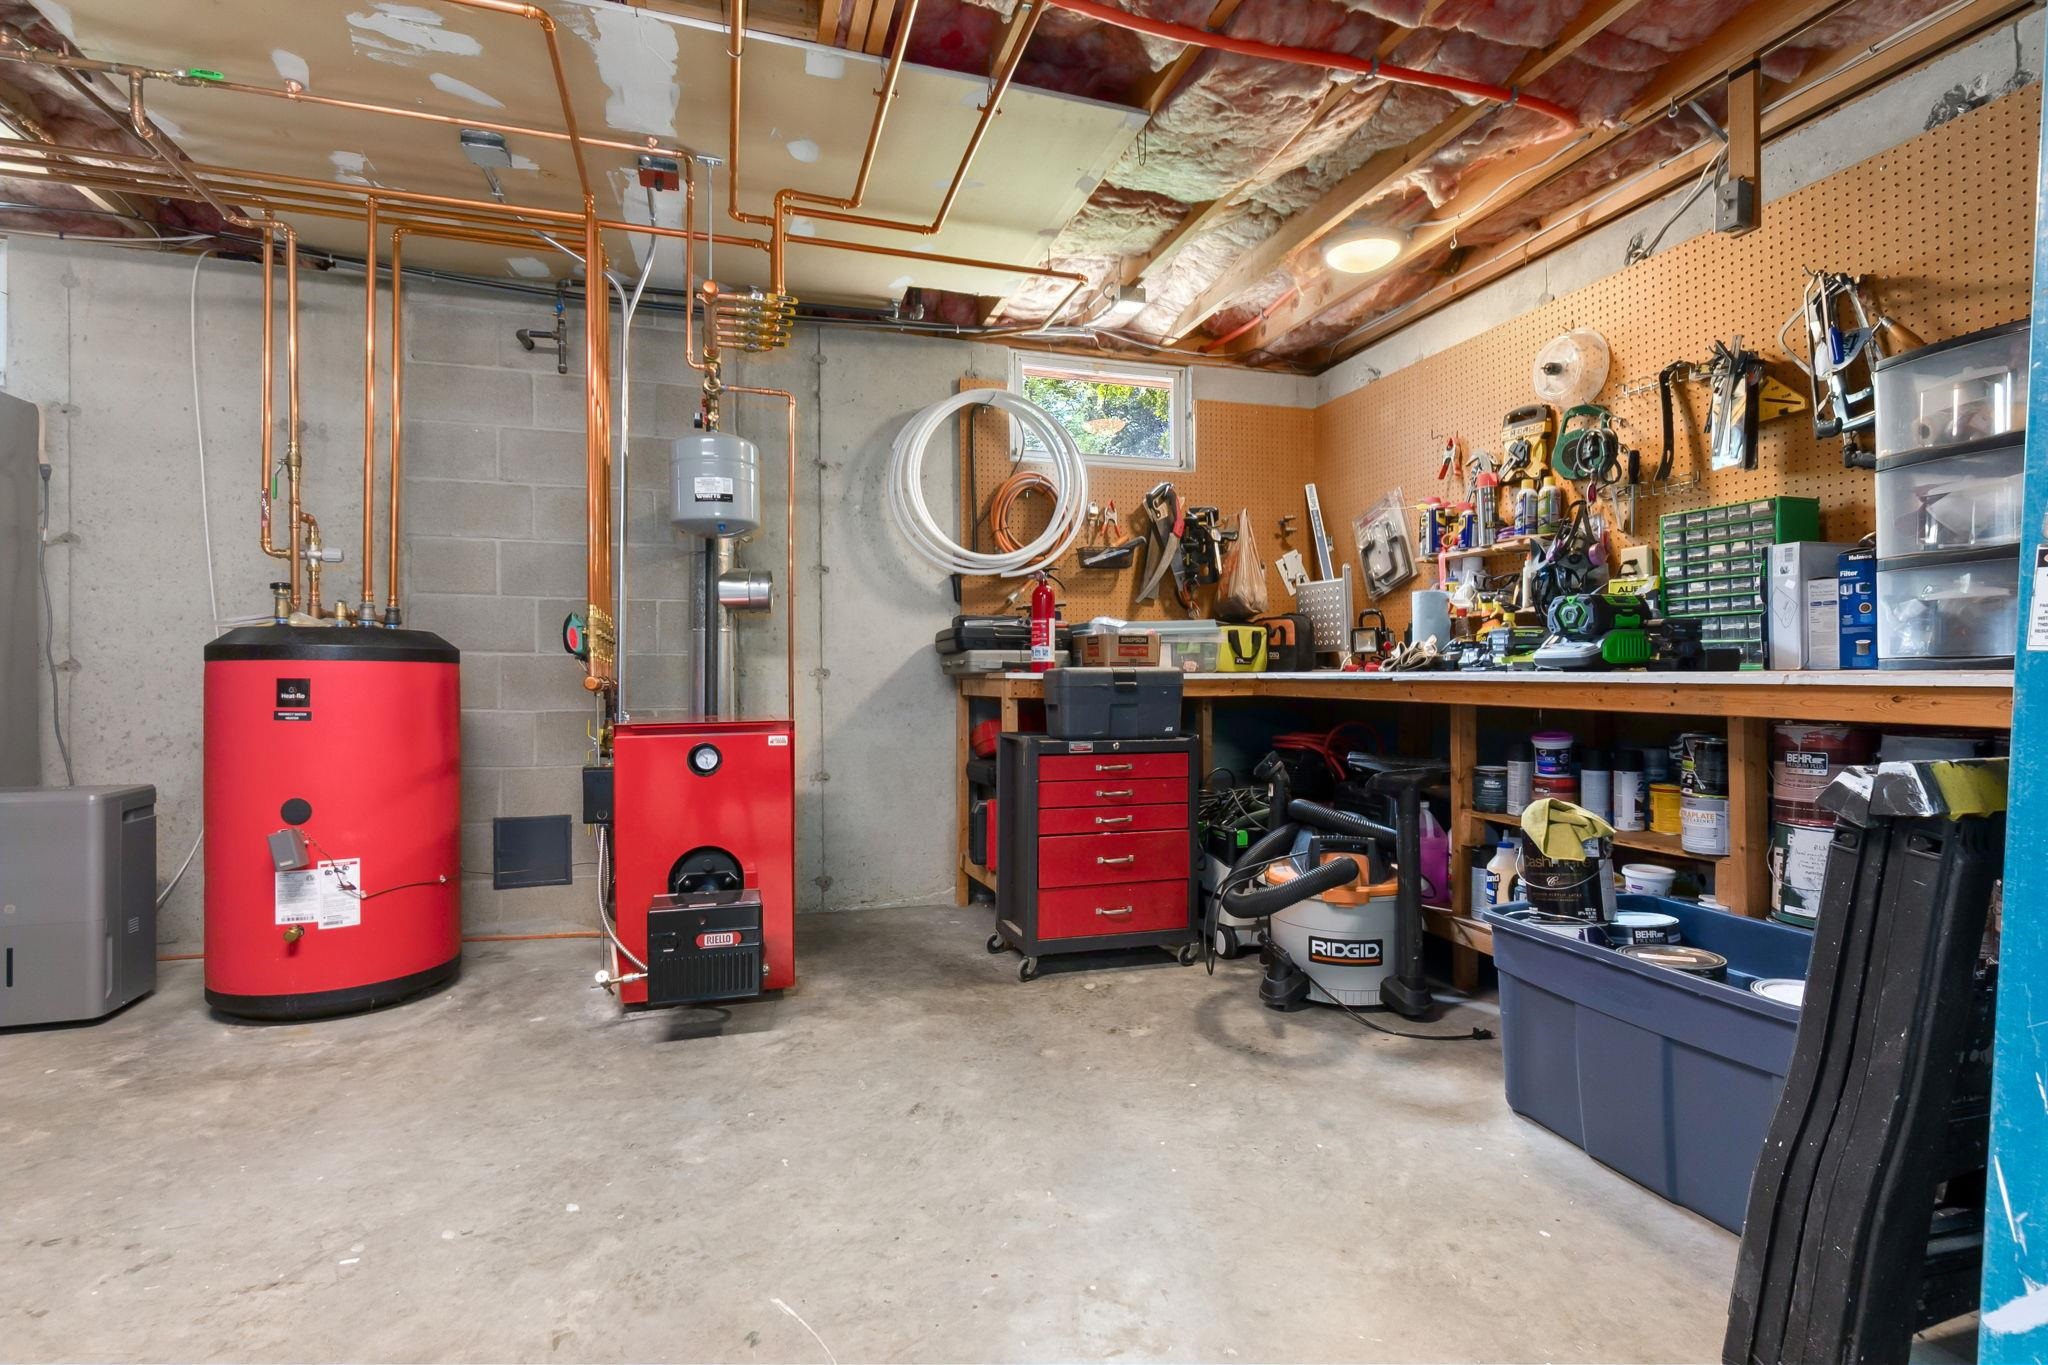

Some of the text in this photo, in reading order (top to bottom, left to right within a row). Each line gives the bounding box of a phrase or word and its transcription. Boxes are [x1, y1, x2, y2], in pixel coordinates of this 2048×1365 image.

[1120, 636, 1148, 644] SIMPSON
[1786, 753, 1812, 763] BEHR
[706, 934, 731, 945] RIELLO
[1634, 930, 1657, 939] BEHR
[1311, 939, 1380, 958] RIDGID
